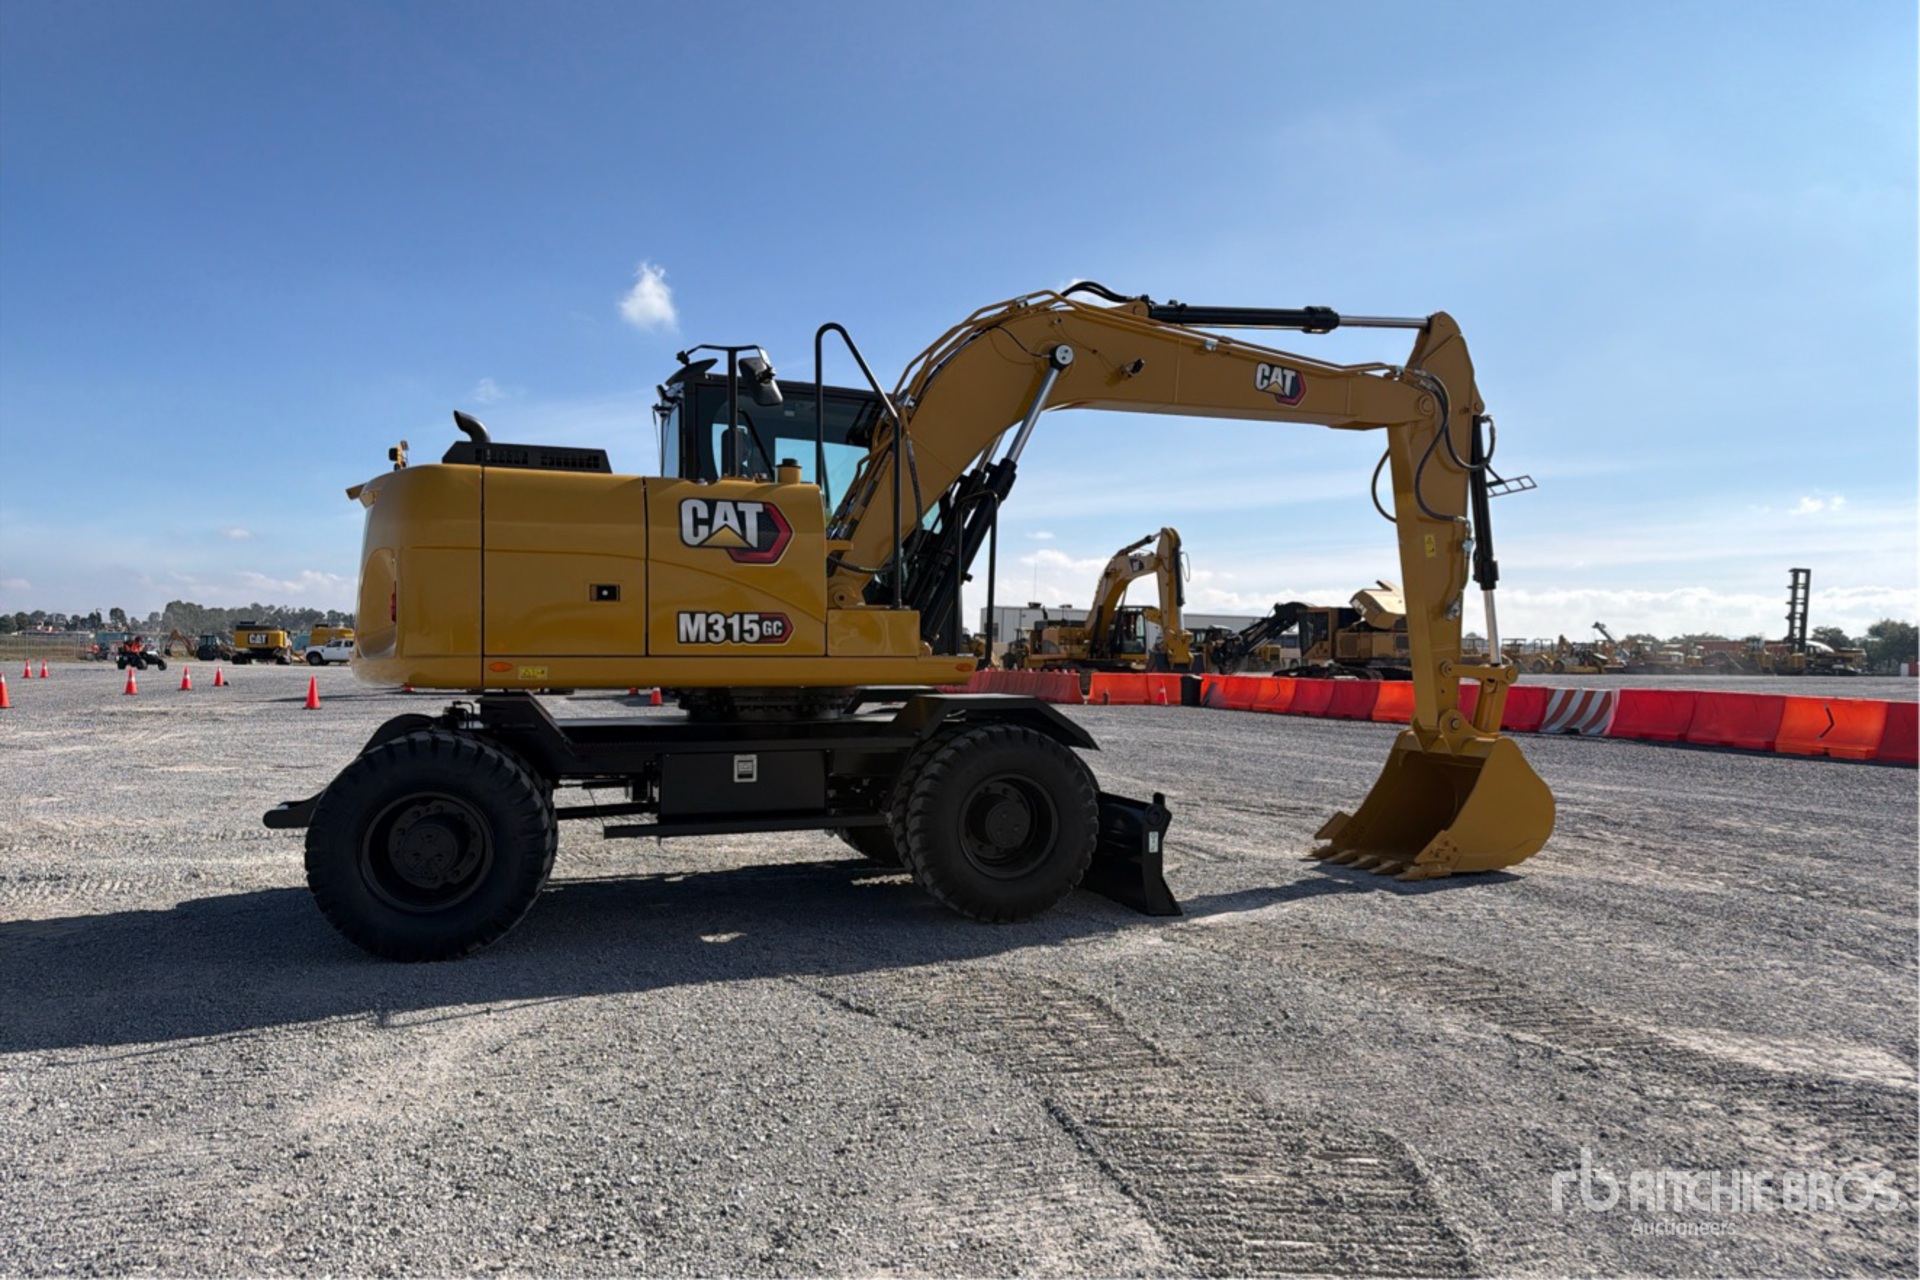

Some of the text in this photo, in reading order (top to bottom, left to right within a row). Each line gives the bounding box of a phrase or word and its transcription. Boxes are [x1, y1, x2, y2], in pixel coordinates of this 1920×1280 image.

[1255, 363, 1296, 396] CAT
[681, 499, 764, 548] CAT
[249, 633, 267, 644] CAT
[678, 613, 783, 642] M315 GC
